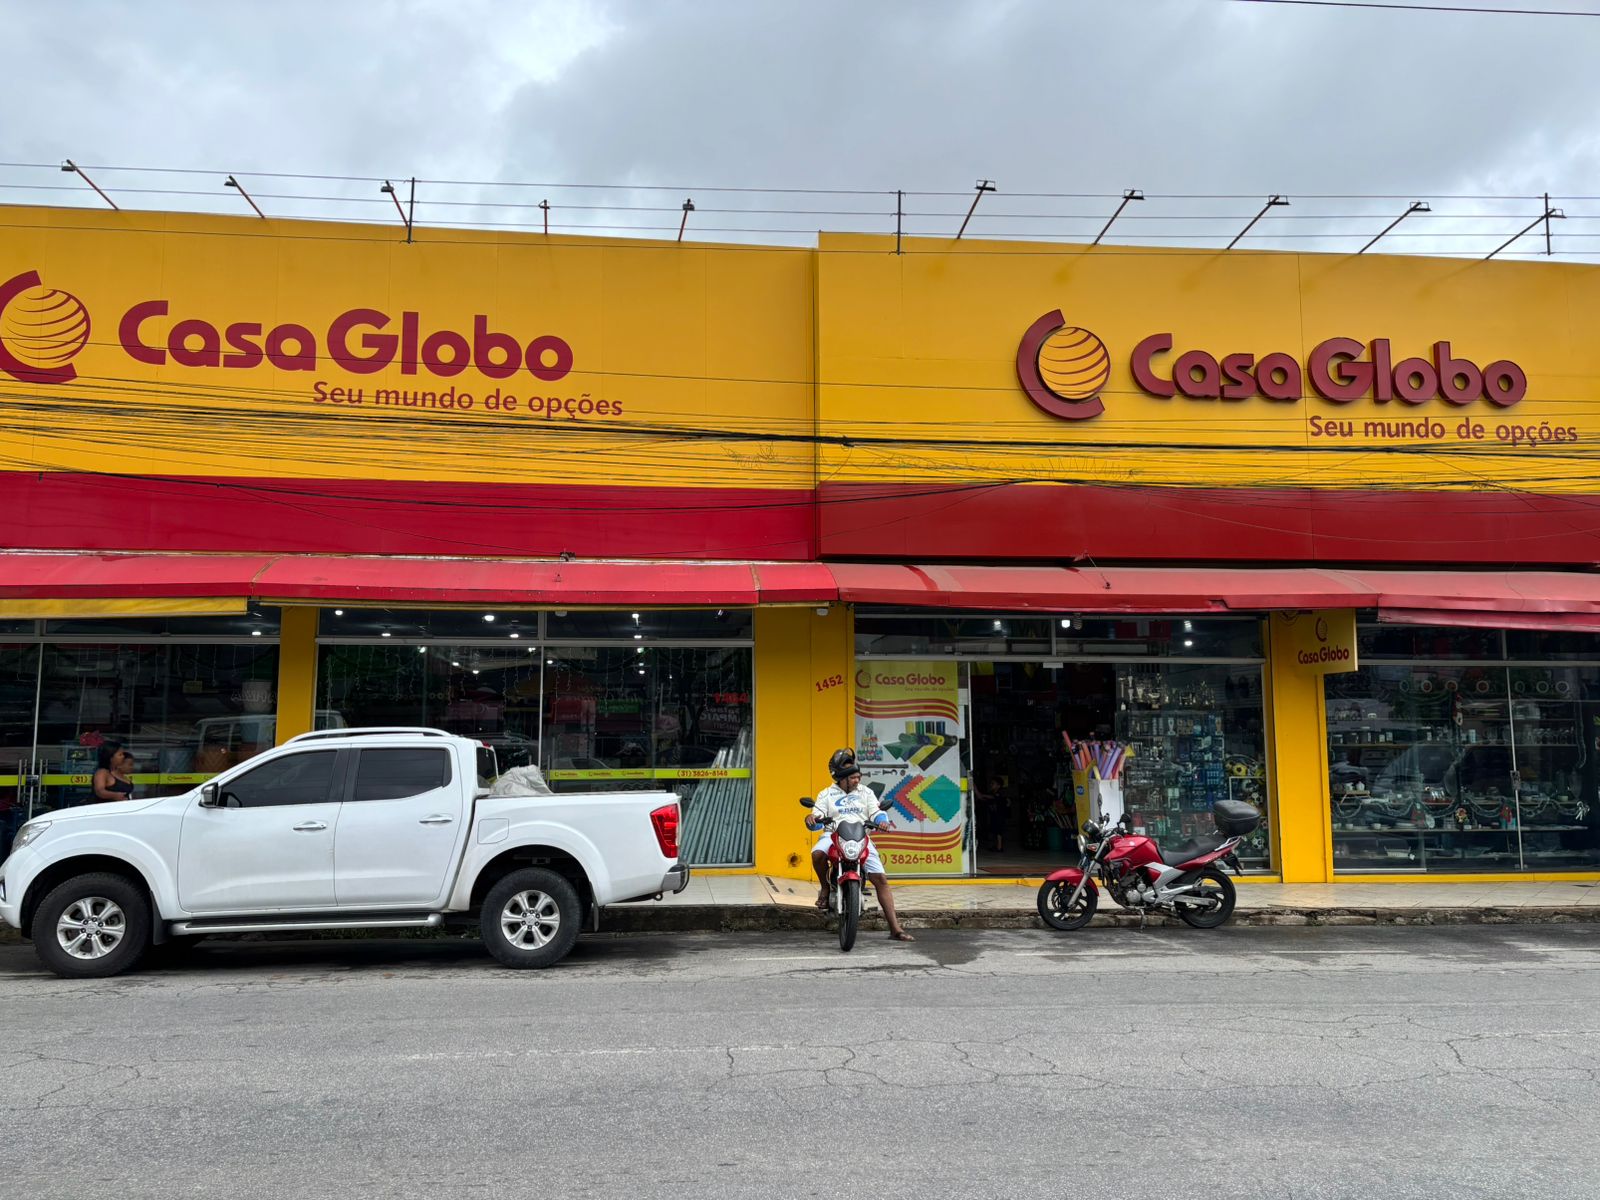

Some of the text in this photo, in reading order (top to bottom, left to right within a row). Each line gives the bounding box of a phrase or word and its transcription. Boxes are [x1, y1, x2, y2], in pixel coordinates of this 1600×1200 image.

[312, 381, 624, 420] Seu mundo de opções
[1309, 415, 1578, 448] Seu mundo de opções
[815, 674, 844, 692] 1452
[70, 775, 88, 784] (31)
[890, 853, 953, 865] 3826-8148
